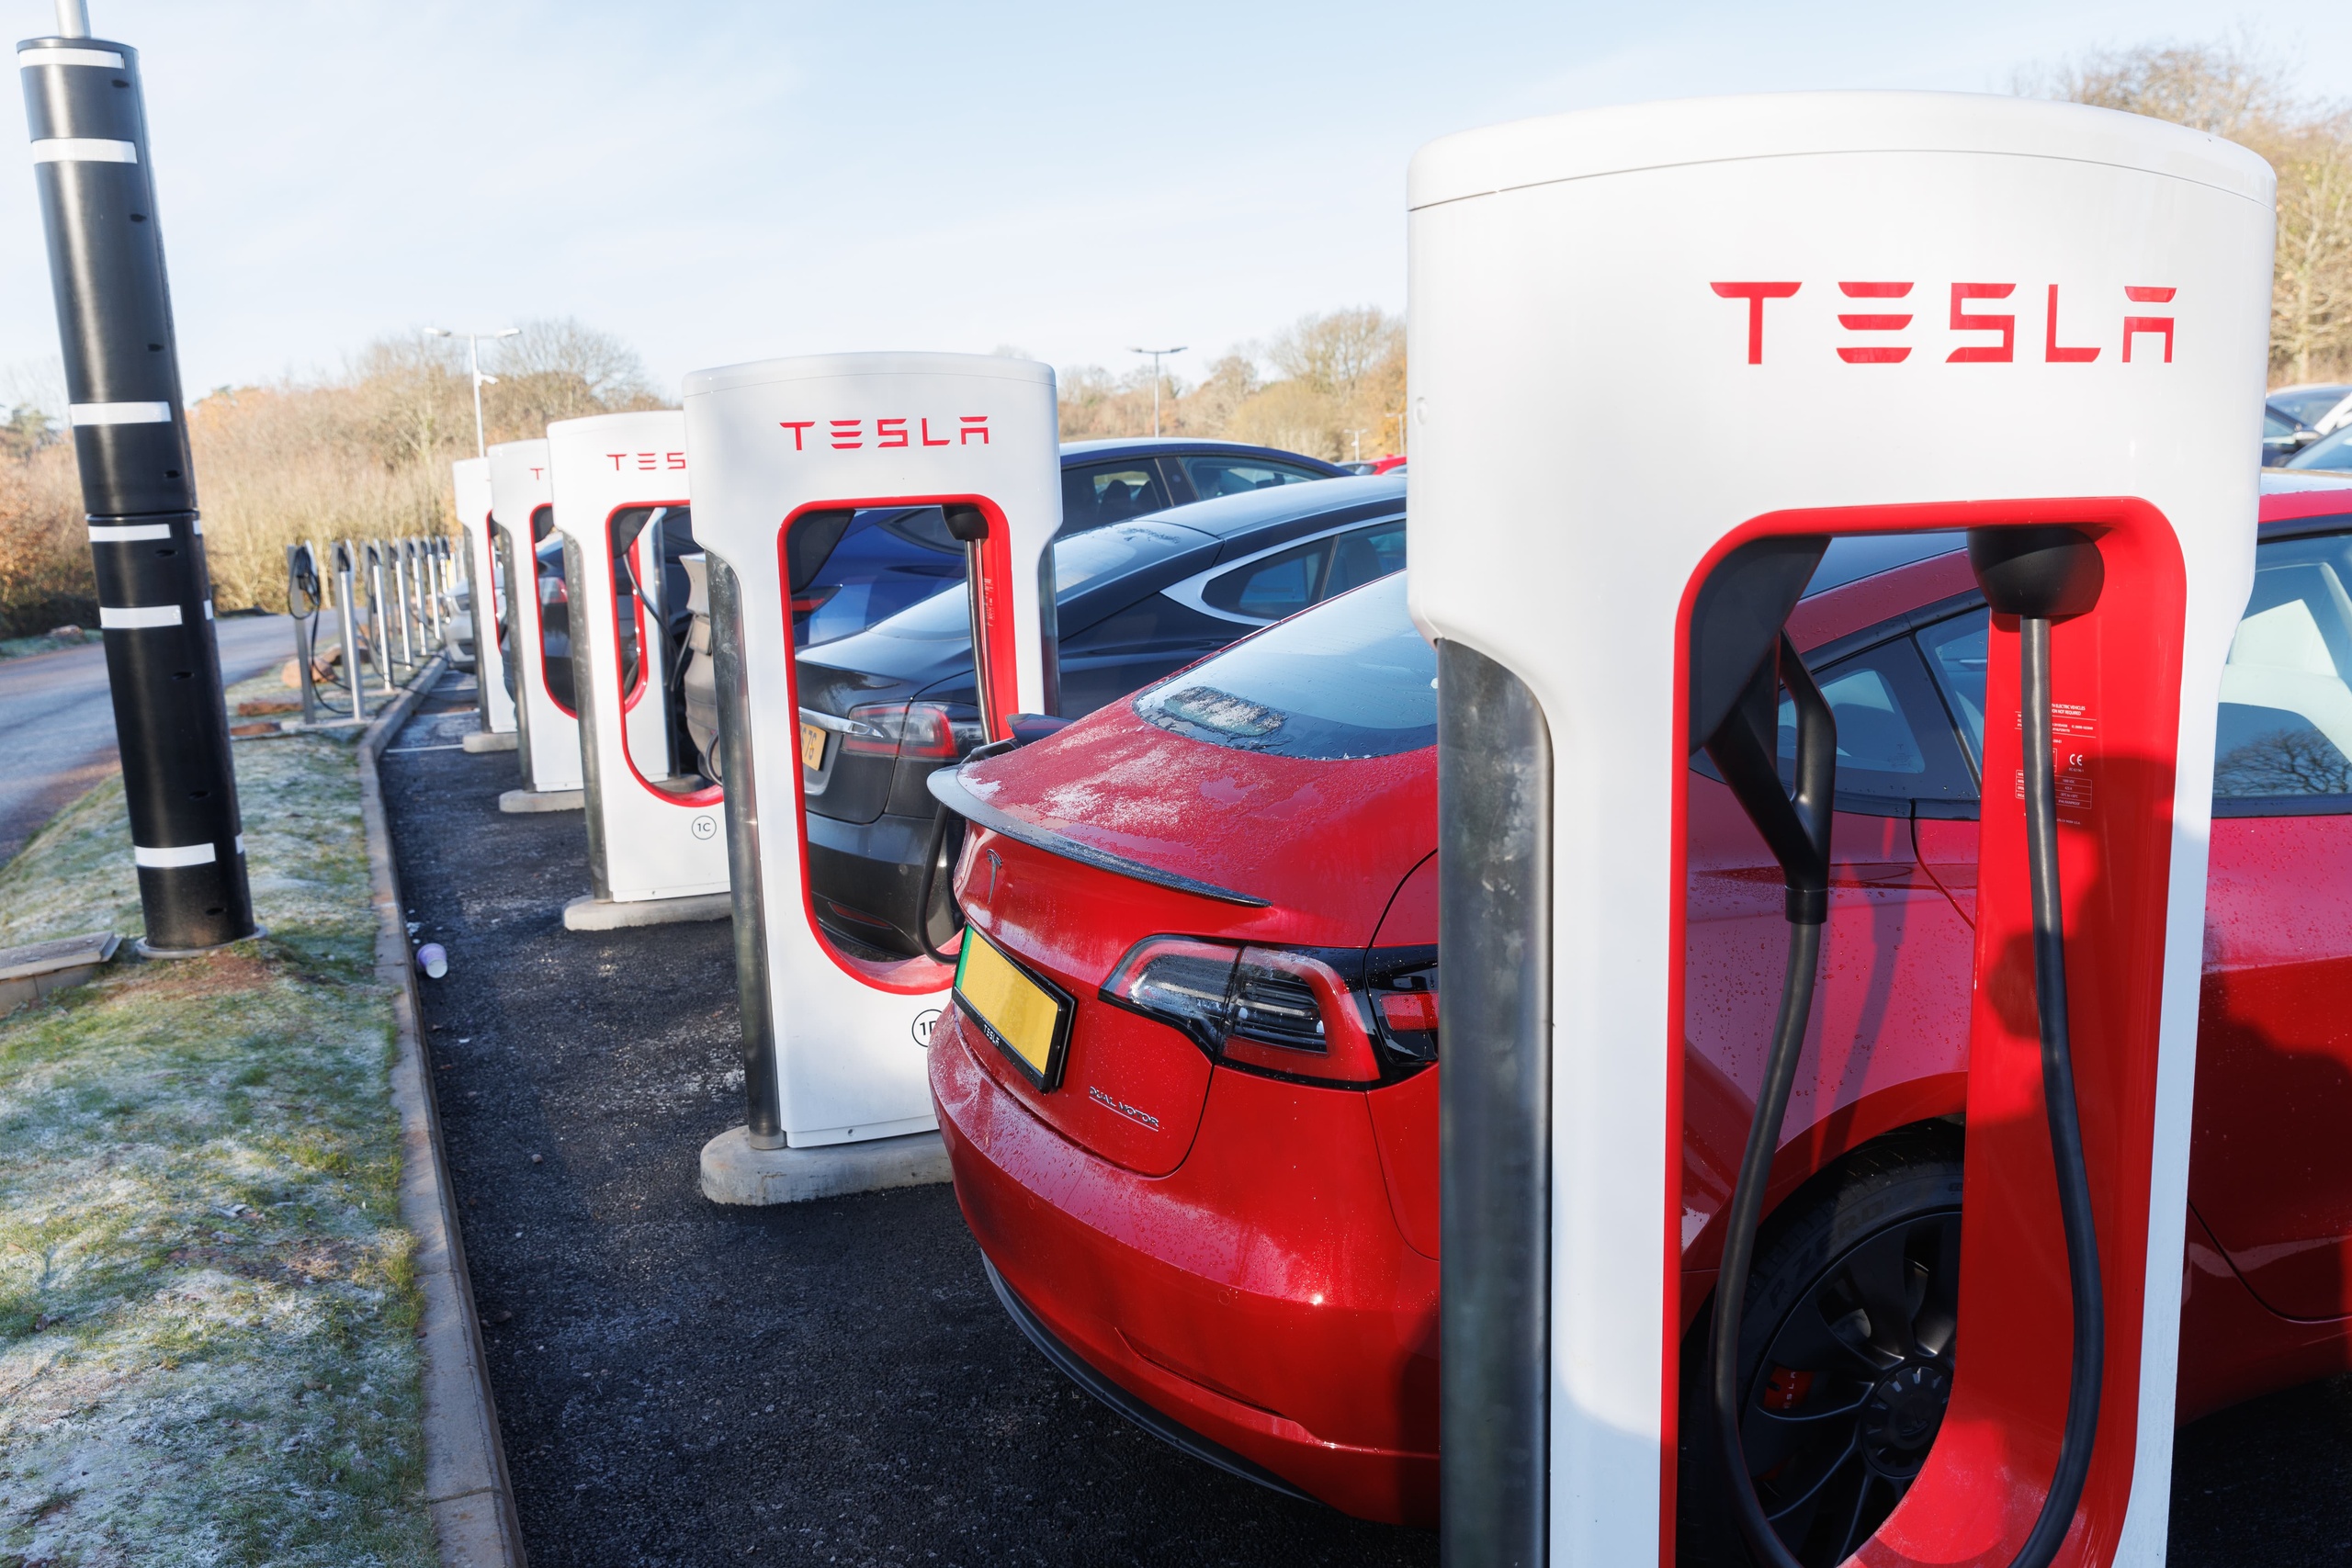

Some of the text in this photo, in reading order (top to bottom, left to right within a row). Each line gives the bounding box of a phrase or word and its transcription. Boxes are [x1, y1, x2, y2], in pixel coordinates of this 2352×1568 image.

[1709, 281, 2177, 365] TESLA
[778, 416, 989, 451] TESLA
[606, 452, 686, 471] TES
[2069, 753, 2083, 766] CE
[697, 822, 711, 832] 1C
[983, 1023, 1000, 1047] TESLA
[1089, 1086, 1159, 1128] DUAL MOTOR
